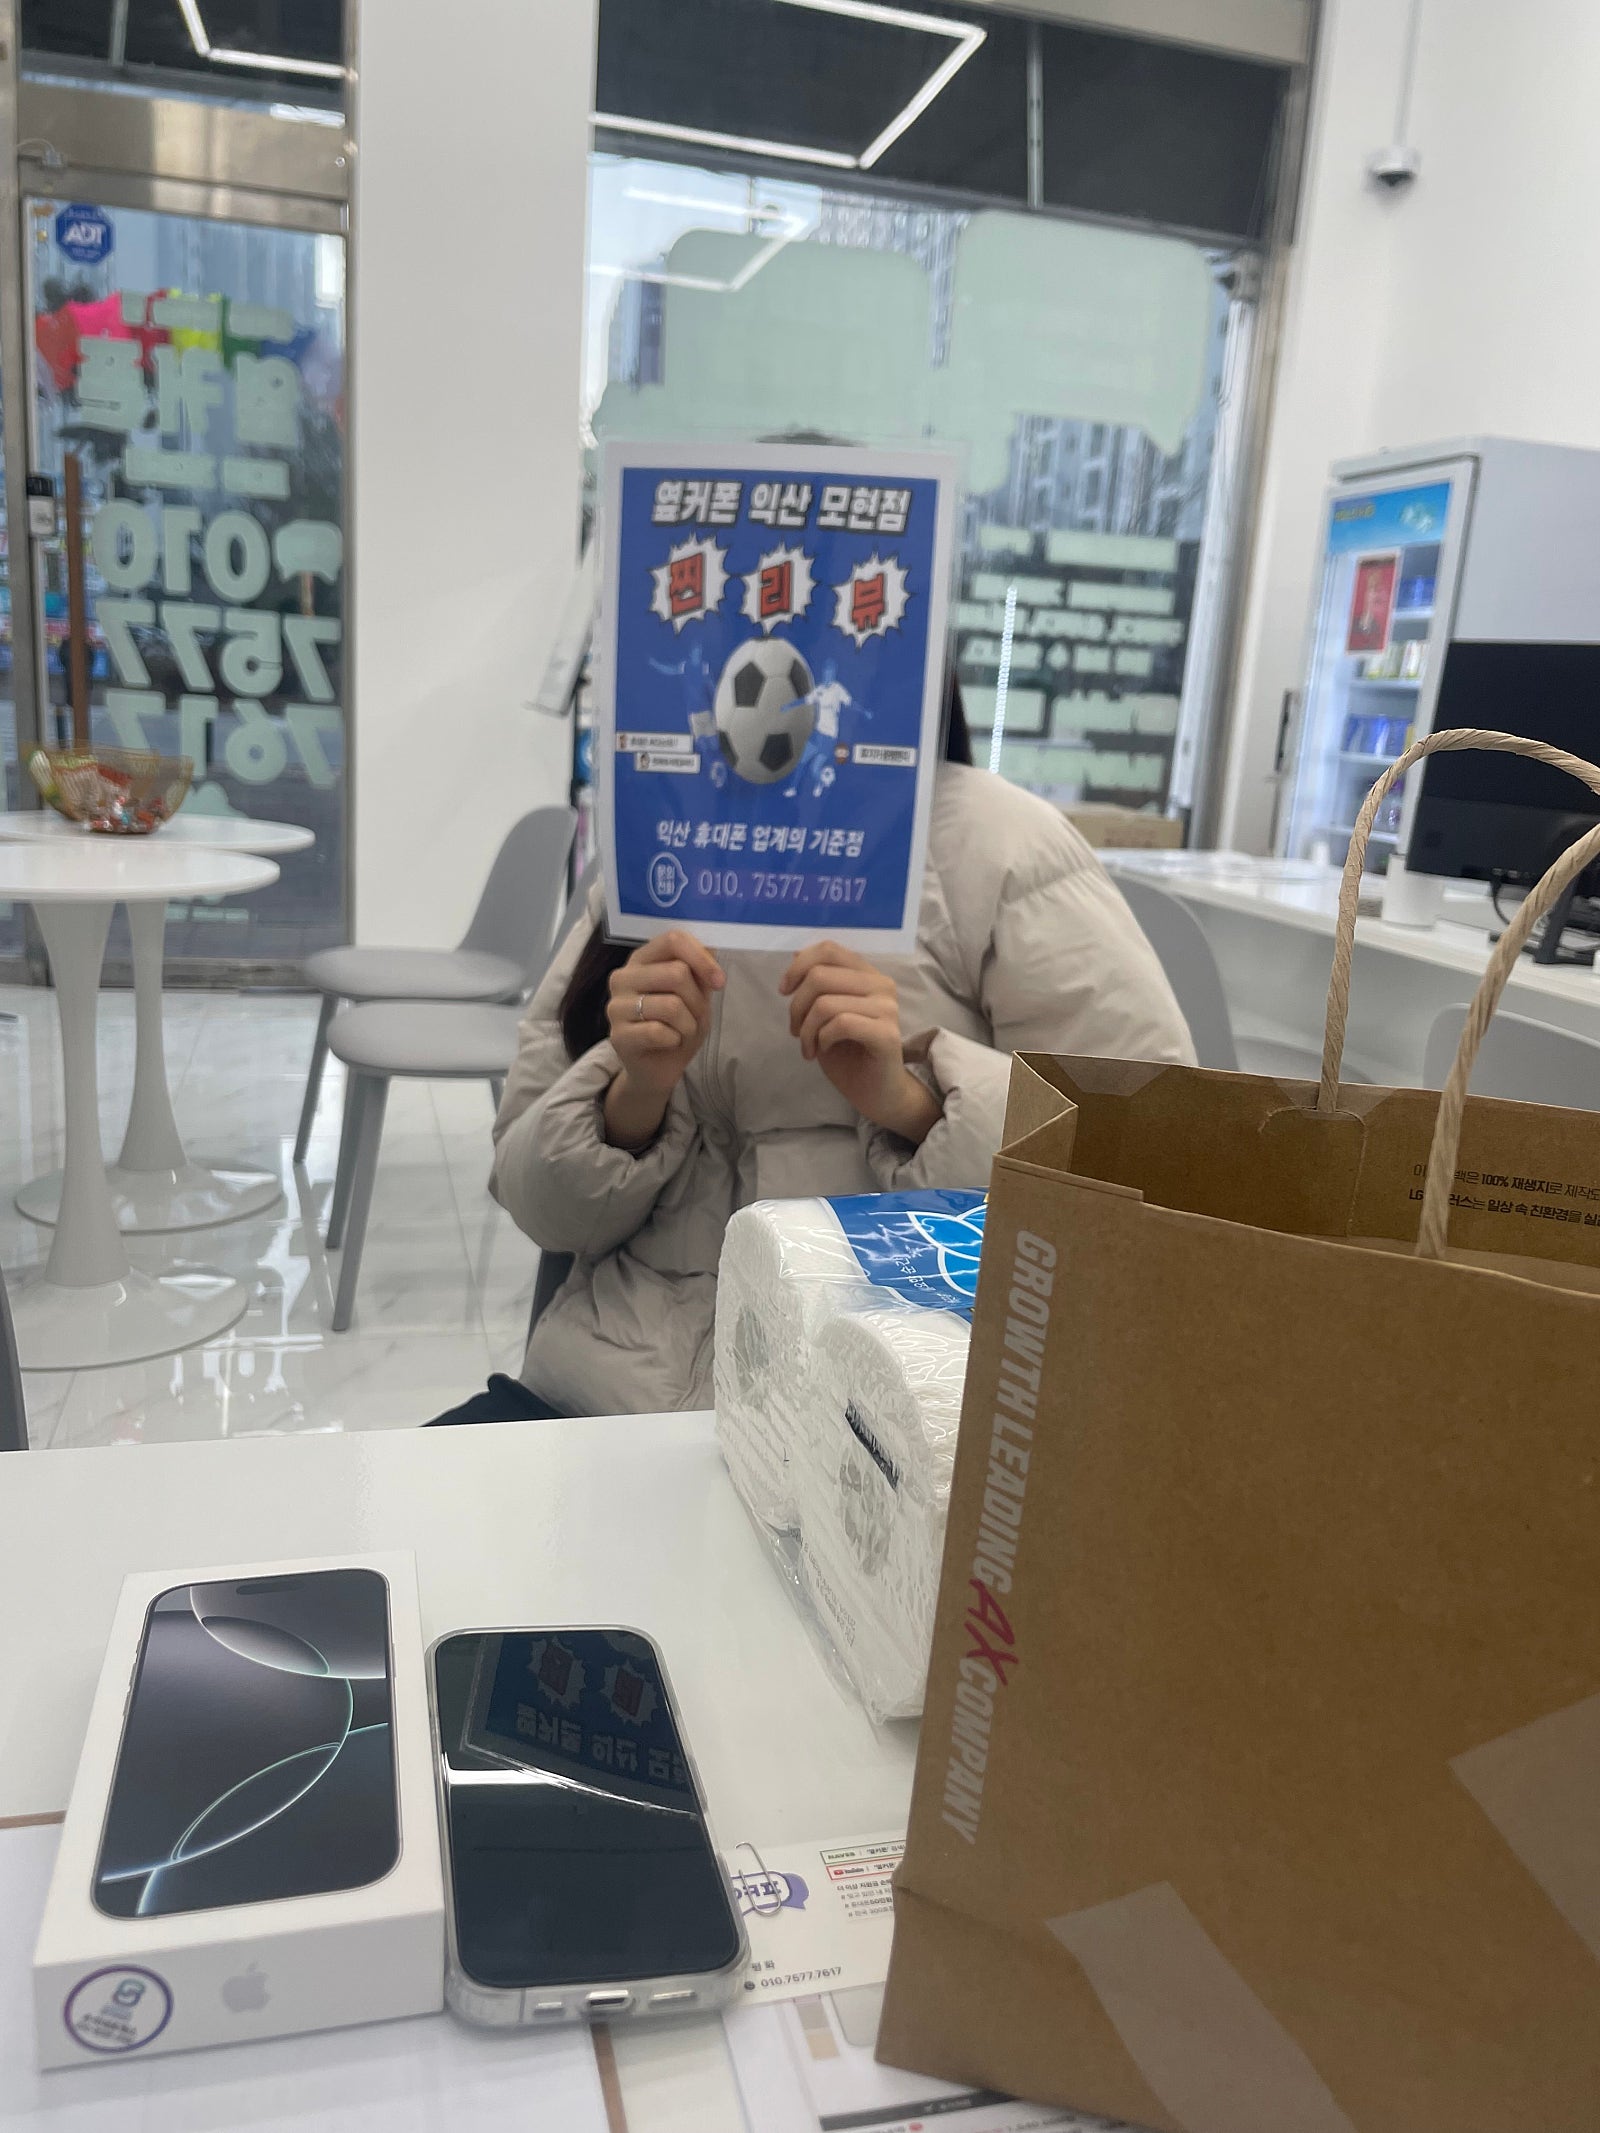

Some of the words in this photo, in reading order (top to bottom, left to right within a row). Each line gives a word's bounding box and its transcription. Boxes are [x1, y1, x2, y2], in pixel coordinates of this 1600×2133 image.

[63, 221, 106, 246] ADT
[749, 483, 812, 528] 익산
[817, 486, 912, 533] 모현점
[657, 820, 690, 848] 익산
[693, 821, 748, 851] 휴대폰
[752, 825, 807, 854] 업계의
[808, 828, 865, 858] 기준점
[817, 875, 867, 903] 7617
[1481, 1173, 1510, 1188] 100%
[1511, 1176, 1563, 1195] 재생지로
[1409, 1189, 1485, 1210] LG러스는
[1488, 1199, 1513, 1213] 일상
[1515, 1203, 1528, 1216] 속
[1530, 1204, 1582, 1223] 친환경을
[995, 1230, 1057, 1419] GROWTH
[972, 1412, 1034, 1594] LEADING
[942, 1657, 997, 1845] COMPANY
